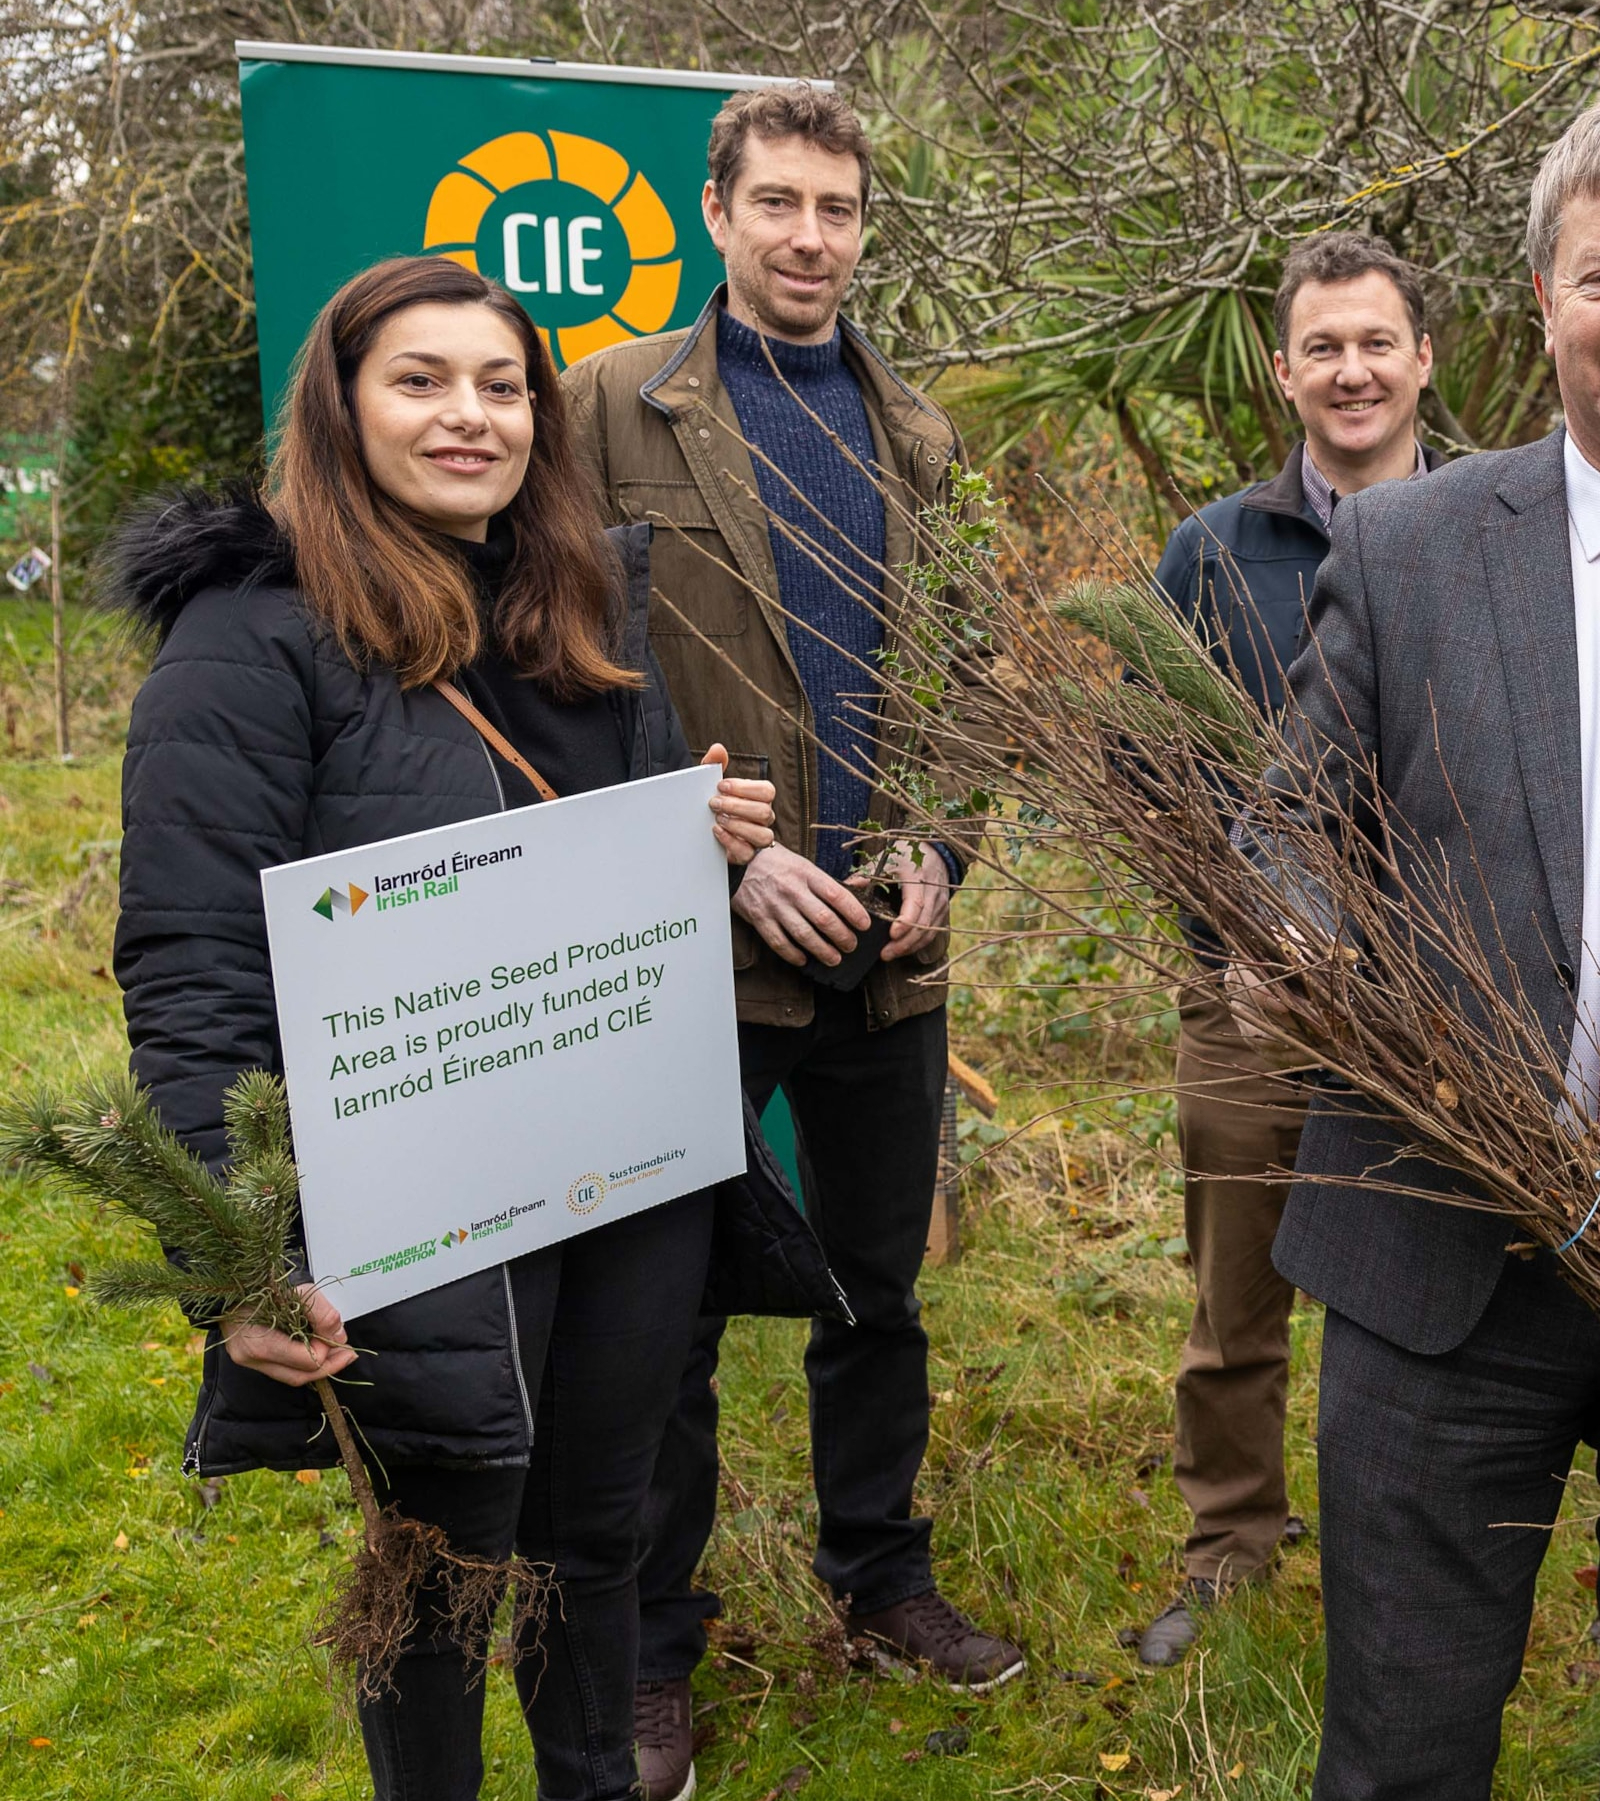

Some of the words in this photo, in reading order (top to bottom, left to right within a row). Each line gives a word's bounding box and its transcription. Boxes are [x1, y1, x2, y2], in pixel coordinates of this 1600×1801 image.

[503, 213, 604, 296] CIE
[374, 860, 446, 893] Iarnród
[452, 844, 523, 874] Éireann
[376, 887, 419, 911] Irish
[424, 875, 459, 897] Rail
[322, 1004, 385, 1039] This
[394, 977, 481, 1019] Native
[490, 951, 558, 990] Seed
[567, 917, 698, 968] Production
[329, 1044, 396, 1080] Area
[406, 1034, 428, 1057] is
[436, 1001, 534, 1053] proudly
[542, 970, 628, 1015] funded
[637, 963, 666, 989] by
[334, 1068, 433, 1120] Iarnród
[443, 1038, 544, 1086] Éireann
[553, 1019, 599, 1051] and
[607, 996, 653, 1033] CIÉ
[609, 1148, 686, 1181] Sustainability
[609, 1177, 636, 1191] Driving
[637, 1167, 664, 1180] Change
[577, 1185, 596, 1204] CIE
[471, 1211, 507, 1232] Iarnród
[508, 1199, 546, 1220] Éireann
[471, 1224, 494, 1241] Irish
[495, 1219, 513, 1234] Rail
[350, 1238, 437, 1276] SUSTAINABILITY
[381, 1262, 394, 1275] IN
[394, 1248, 437, 1271] MOTION
